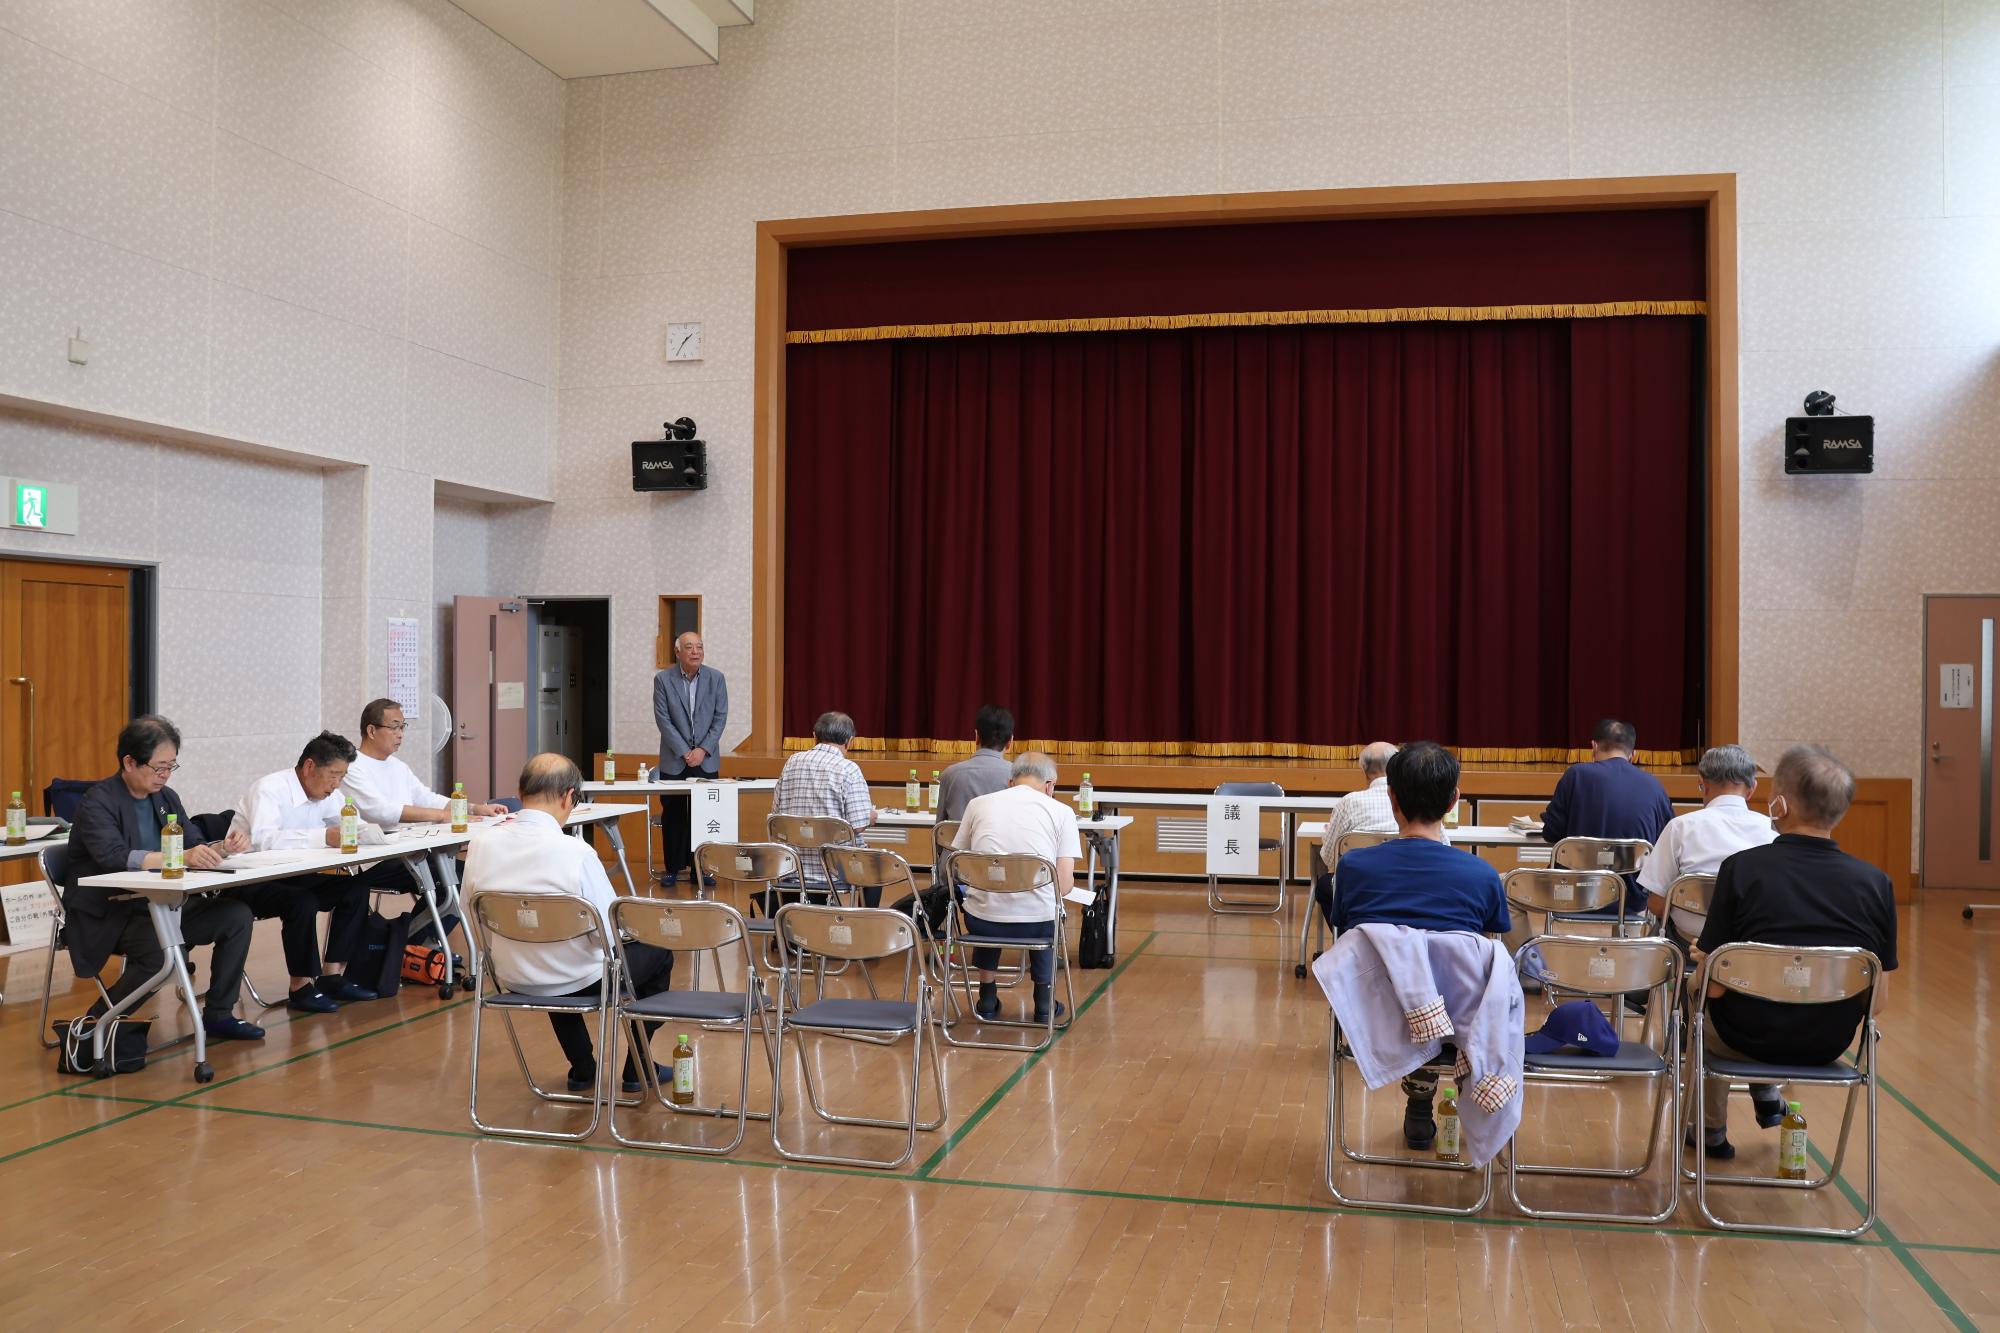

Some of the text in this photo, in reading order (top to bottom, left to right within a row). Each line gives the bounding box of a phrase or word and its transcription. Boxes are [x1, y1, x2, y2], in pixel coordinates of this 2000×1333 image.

[1823, 439, 1863, 450] RAMSA
[641, 461, 674, 470] RAMSA
[707, 788, 721, 834] 司会
[1224, 804, 1241, 855] 議長
